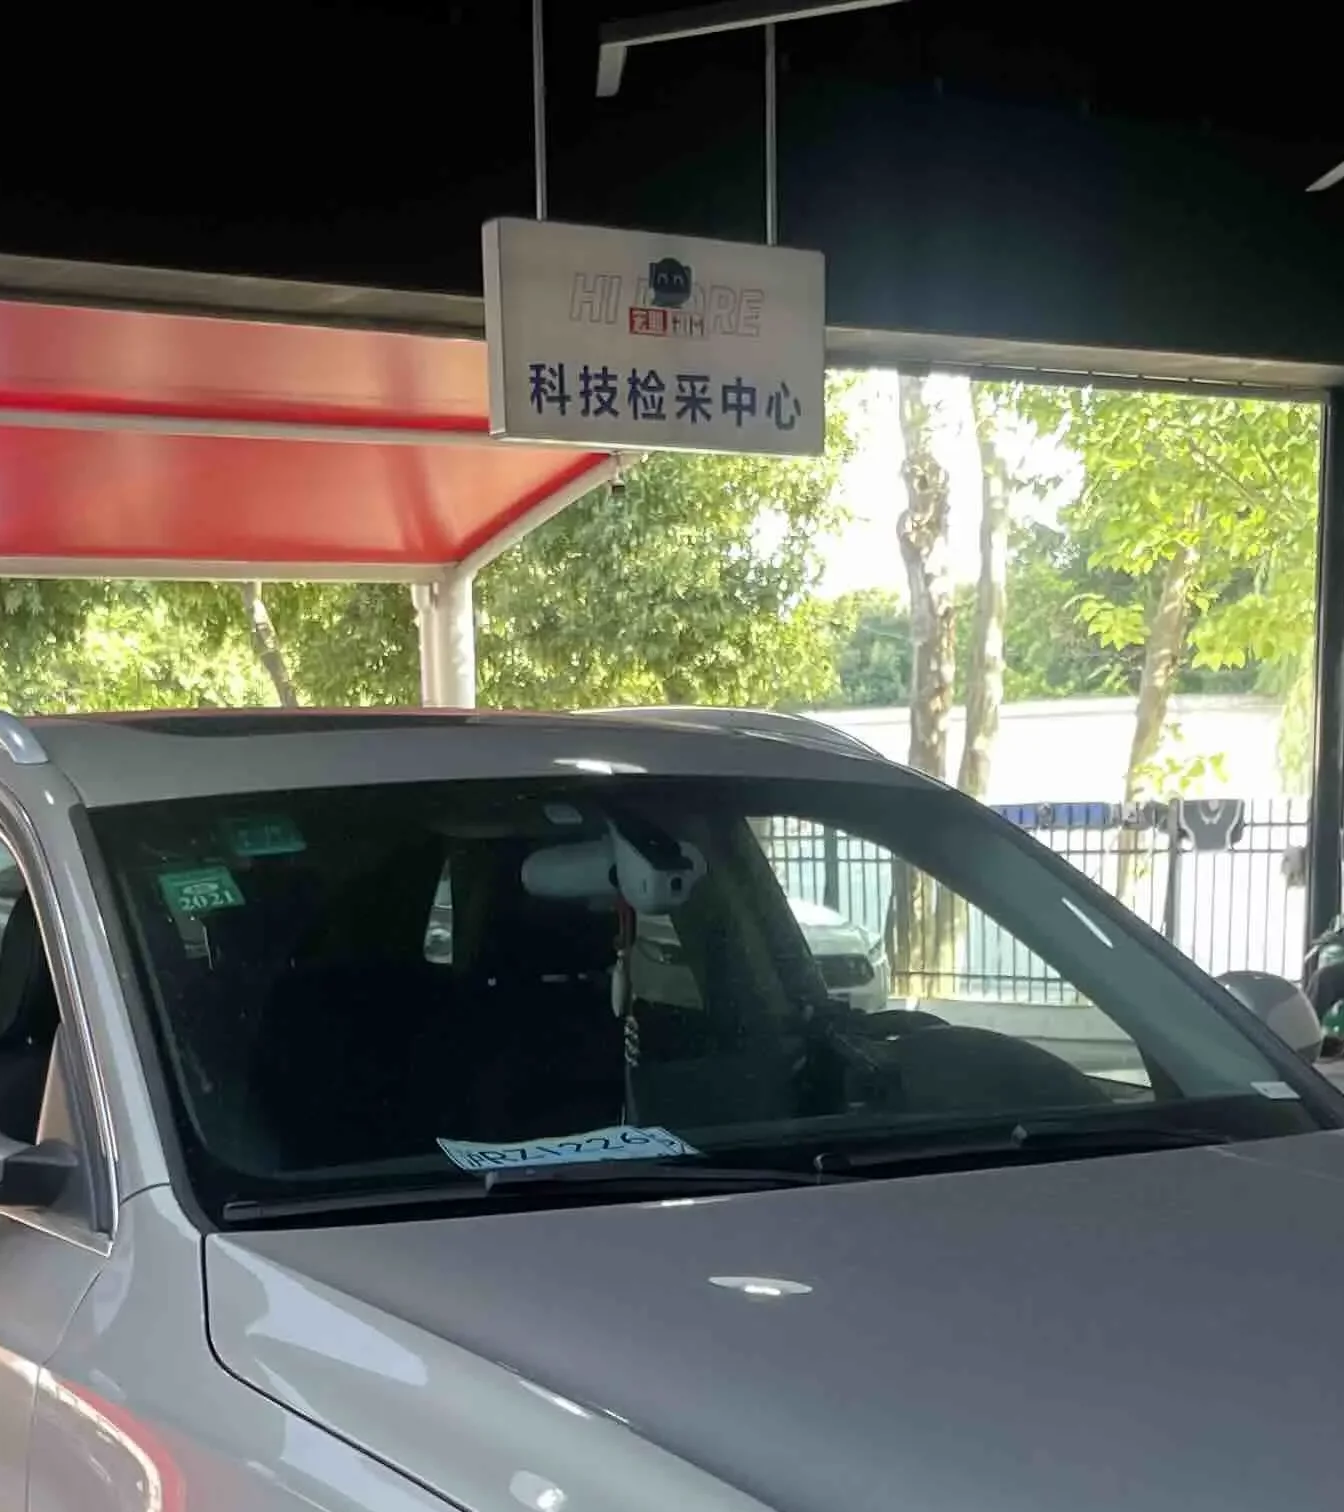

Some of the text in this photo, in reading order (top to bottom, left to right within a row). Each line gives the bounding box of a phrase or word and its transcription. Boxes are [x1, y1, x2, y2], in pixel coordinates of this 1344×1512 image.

[568, 271, 623, 324] HI
[529, 363, 802, 431] 科技检采中心
[178, 890, 235, 911] 2021
